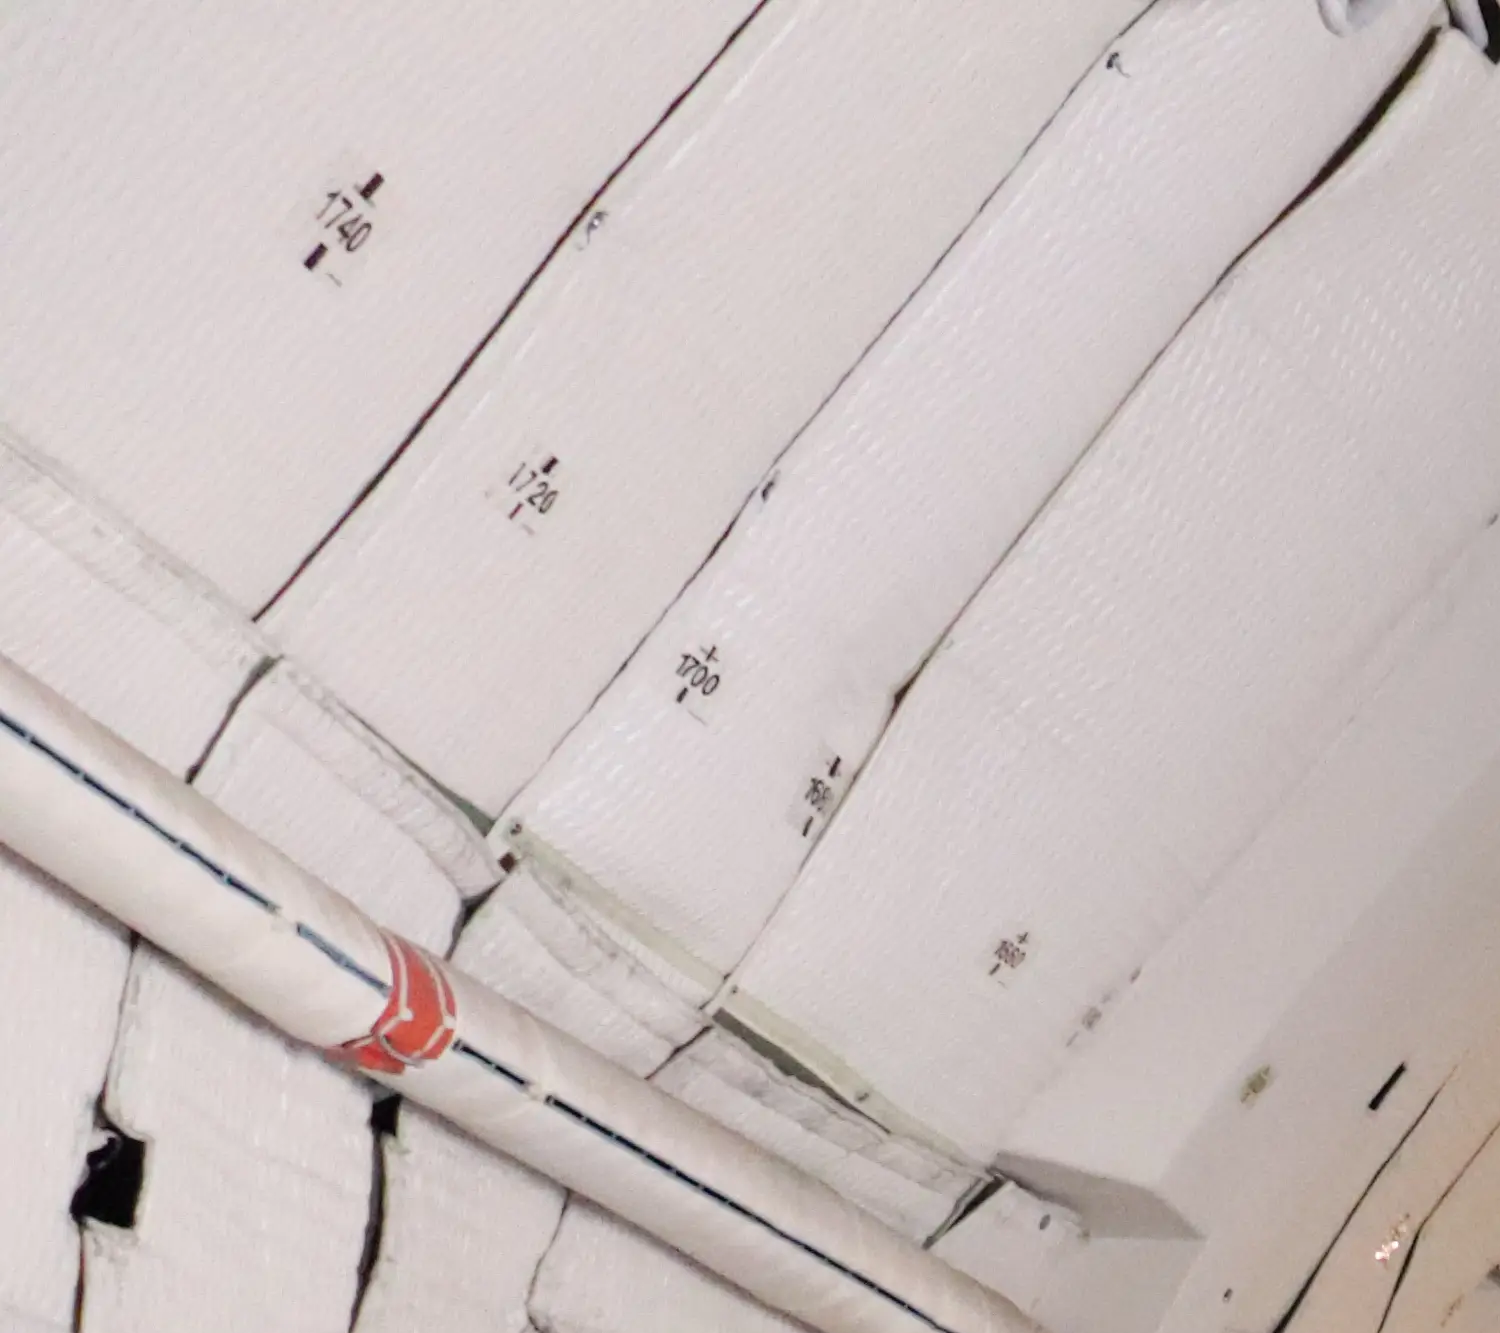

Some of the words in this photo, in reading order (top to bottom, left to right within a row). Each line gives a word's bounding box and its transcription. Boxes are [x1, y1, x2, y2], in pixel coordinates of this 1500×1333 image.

[316, 190, 372, 252] 1740
[509, 462, 558, 514] 1720
[676, 653, 720, 696] 1700
